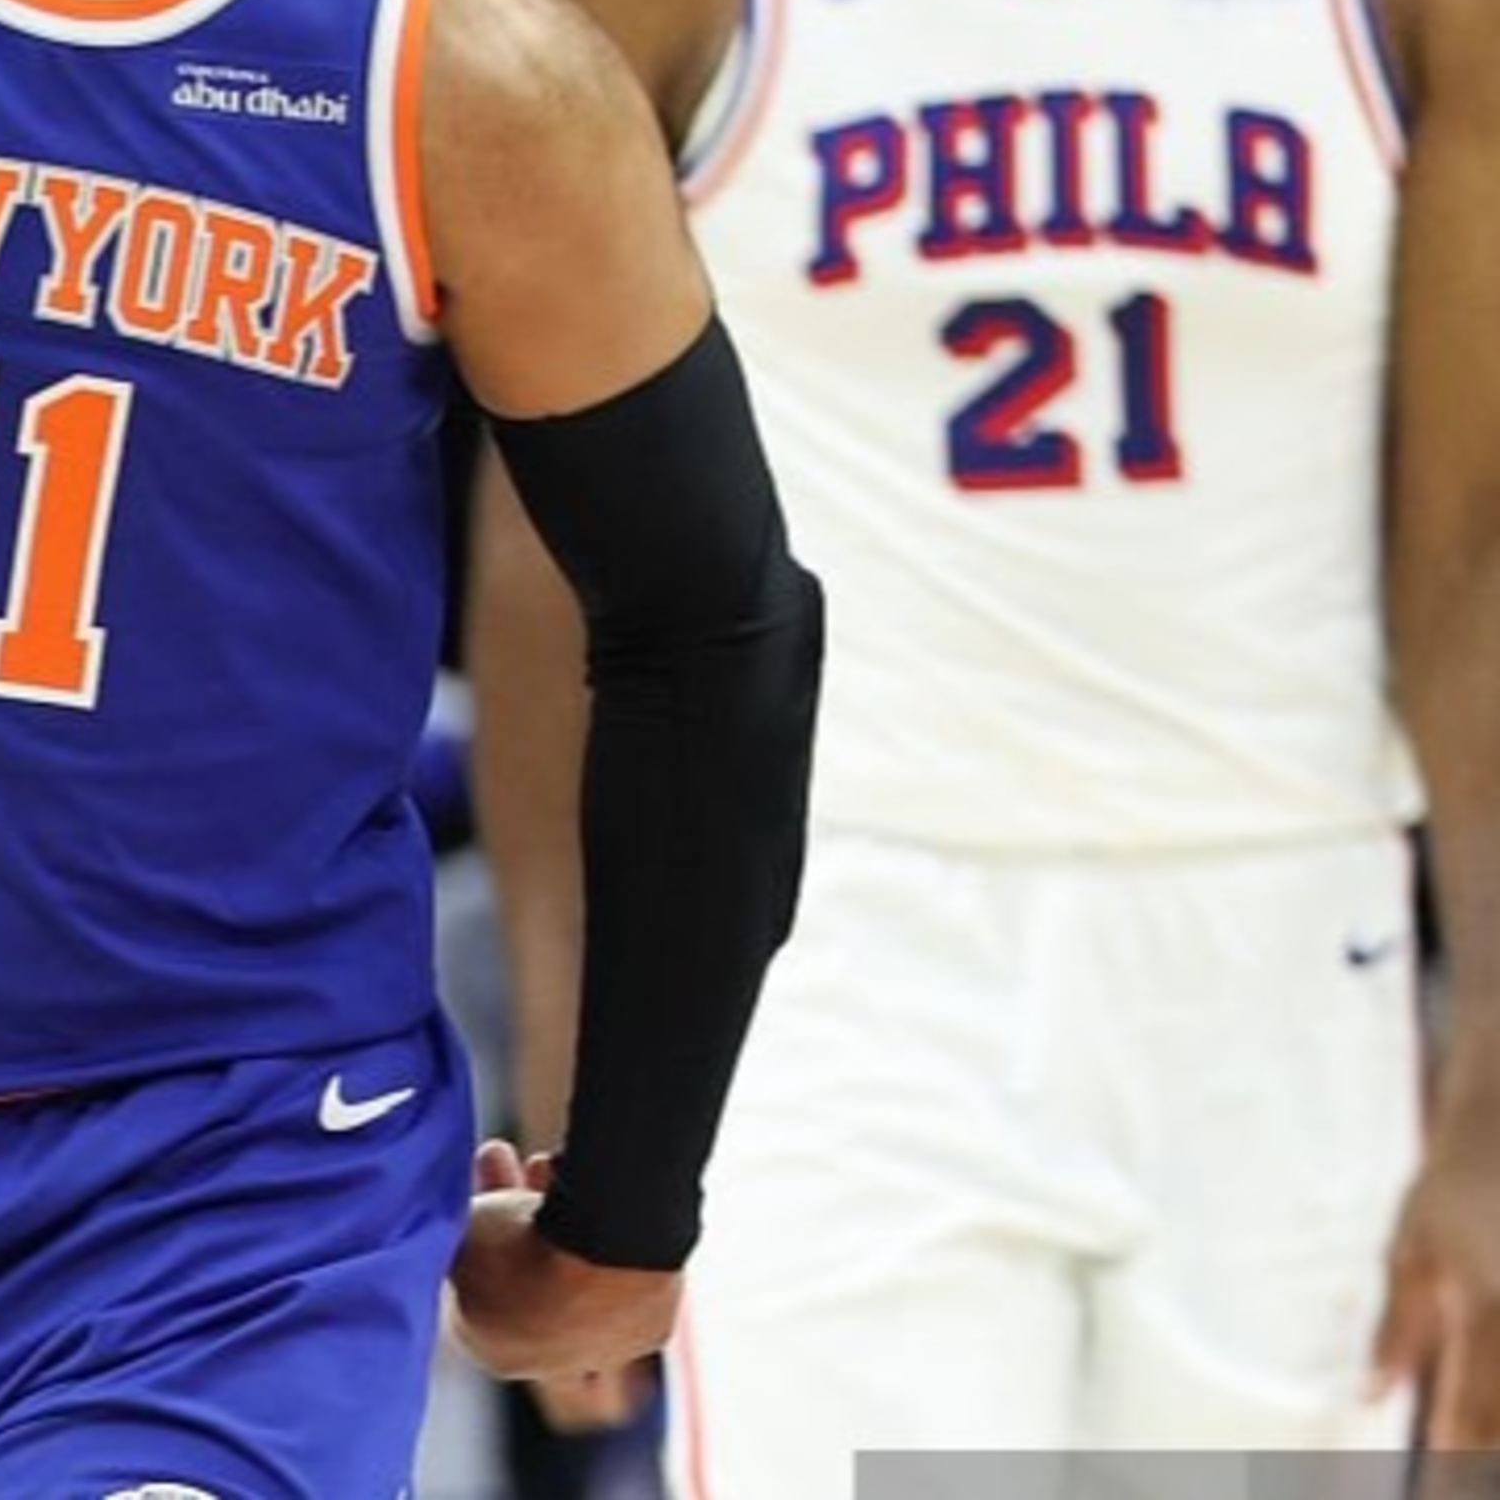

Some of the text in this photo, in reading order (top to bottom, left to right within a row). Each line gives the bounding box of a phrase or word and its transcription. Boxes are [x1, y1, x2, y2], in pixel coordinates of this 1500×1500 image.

[172, 77, 348, 124] abu dhabi
[804, 88, 1320, 288] PHILA
[35, 166, 380, 389] YORK
[937, 290, 1183, 492] 21
